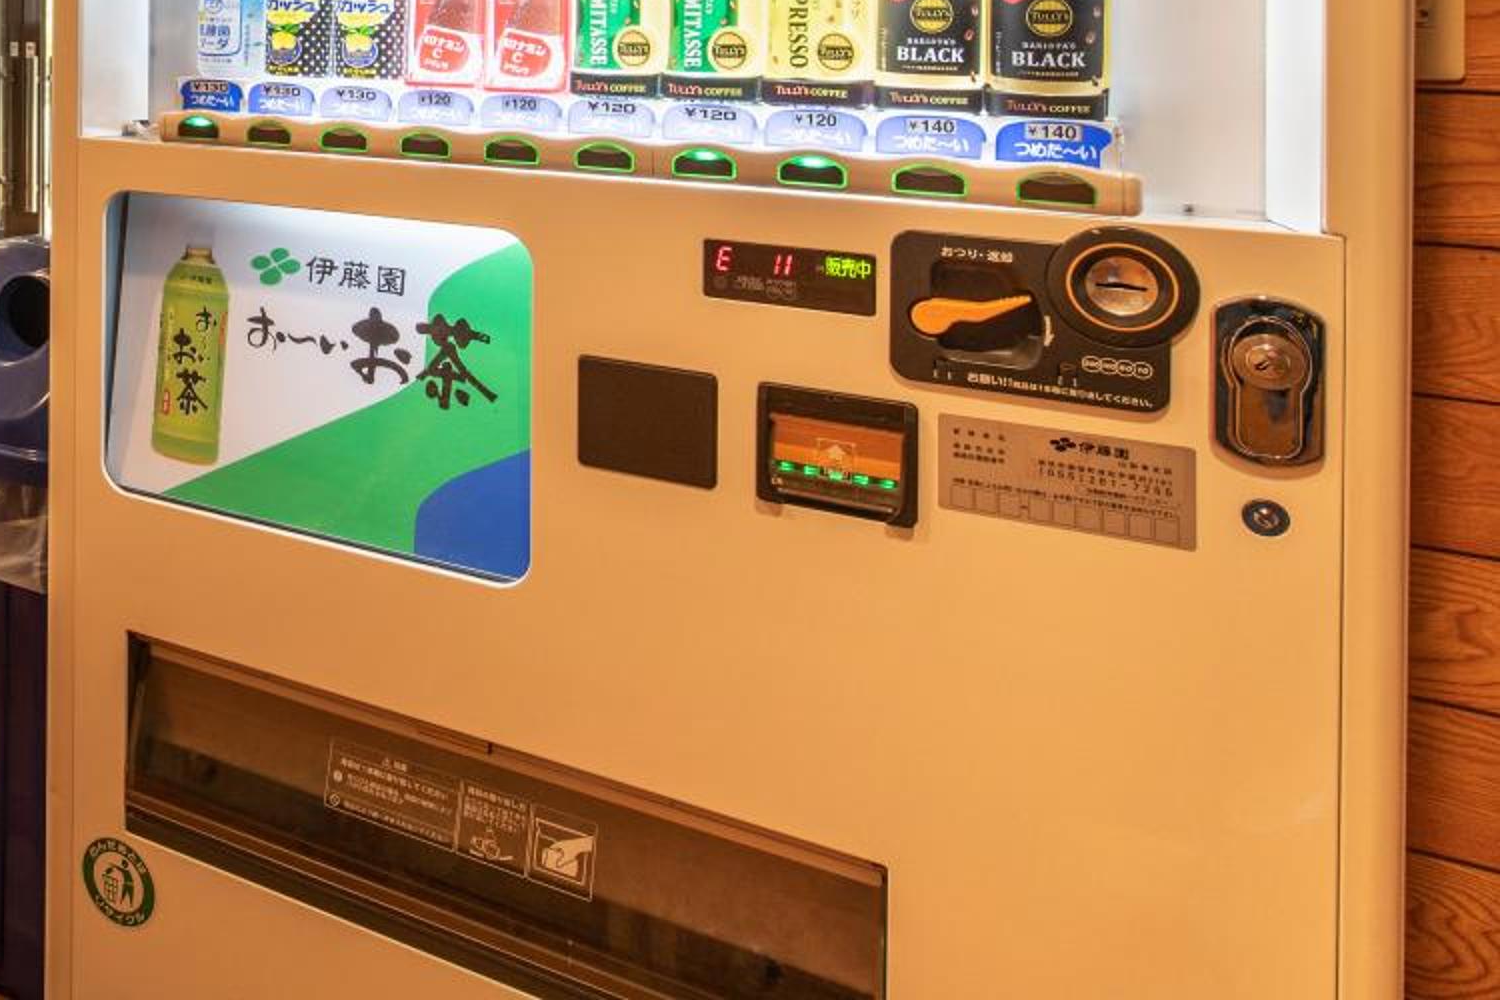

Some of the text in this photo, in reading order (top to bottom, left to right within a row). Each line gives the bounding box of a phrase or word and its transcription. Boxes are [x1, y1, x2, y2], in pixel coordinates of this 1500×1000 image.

[896, 46, 965, 64] BLACK
[1011, 51, 1086, 68] BLACK
[586, 100, 636, 115] ¥120
[684, 107, 737, 122] ¥120
[794, 113, 837, 127] ¥120
[908, 120, 954, 134] ¥140
[1028, 126, 1077, 140] ¥140
[715, 246, 732, 272] E
[825, 255, 872, 279] 販売中
[306, 255, 406, 297] 伊藤園
